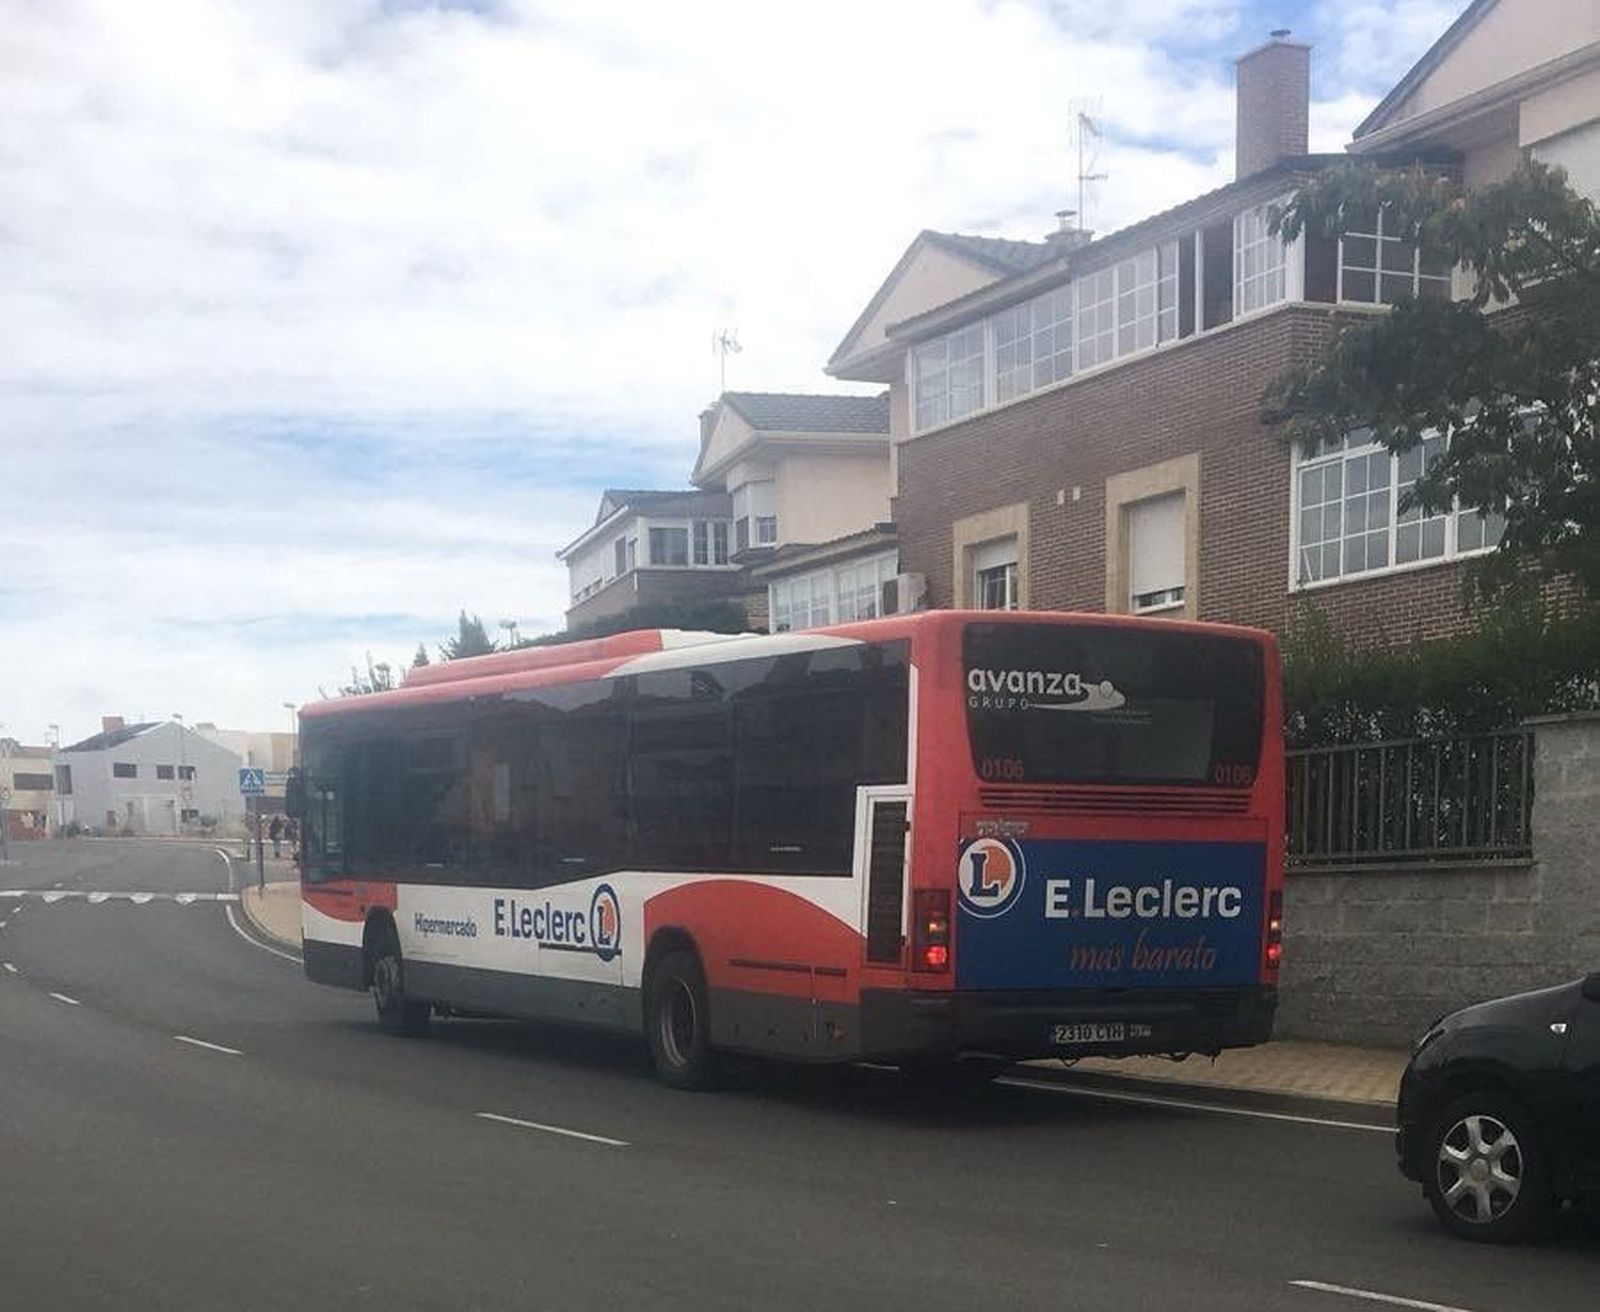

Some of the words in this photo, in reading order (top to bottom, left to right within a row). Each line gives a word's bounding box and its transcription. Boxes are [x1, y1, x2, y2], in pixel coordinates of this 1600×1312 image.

[968, 668, 1081, 695] avanza
[968, 697, 1029, 710] GRUPO
[414, 912, 477, 938] Hipermercado
[1131, 927, 1217, 970] barato
